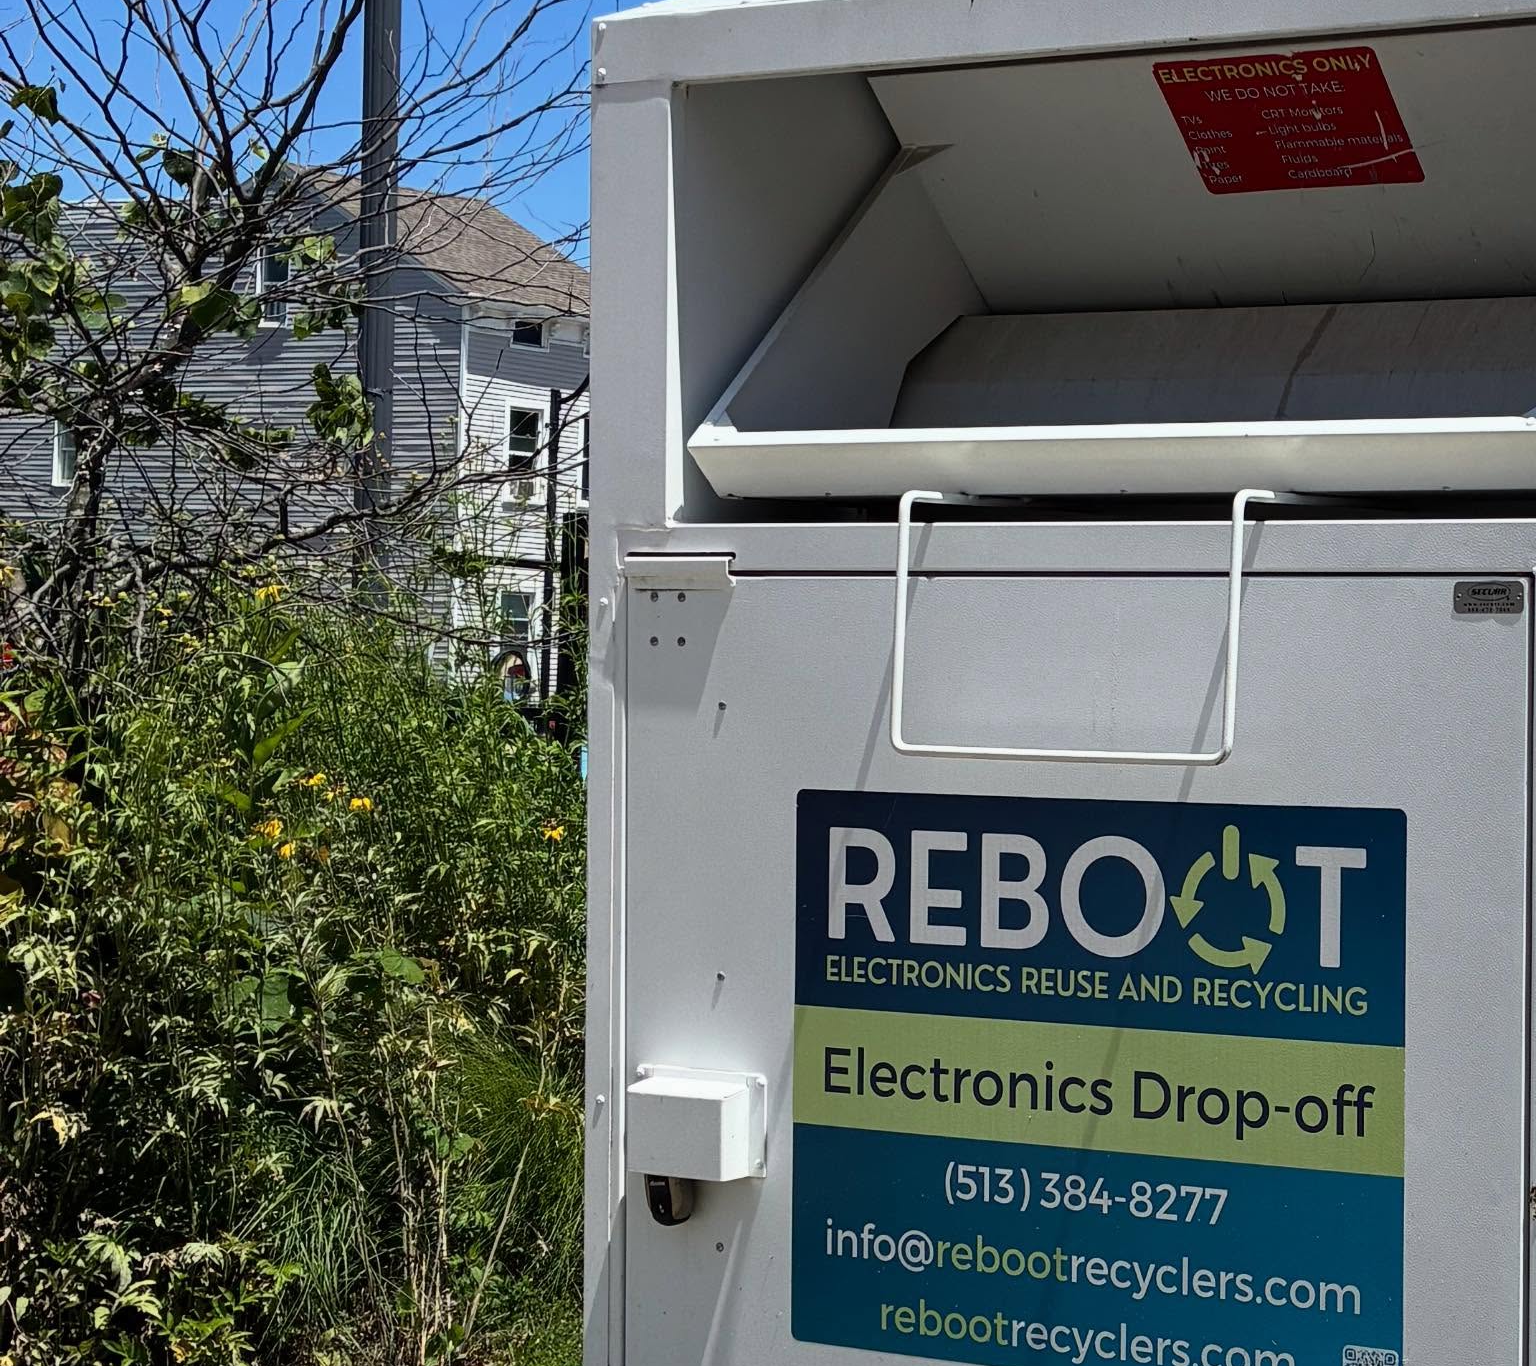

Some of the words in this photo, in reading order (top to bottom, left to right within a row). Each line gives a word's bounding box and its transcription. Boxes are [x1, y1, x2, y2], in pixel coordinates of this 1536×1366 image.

[1158, 58, 1307, 84] ELECTRONICS
[1312, 53, 1371, 73] ONLY
[1204, 88, 1232, 103] WE
[1235, 87, 1260, 101] DO
[1263, 84, 1297, 98] NOT
[1298, 80, 1346, 95] TAKE:
[1261, 108, 1286, 120] CRT
[1188, 128, 1233, 141] Clothes
[1268, 122, 1299, 137] Light
[1301, 121, 1337, 134] bulbs
[1274, 136, 1345, 150] Flammable
[1281, 152, 1319, 165] Fluids
[825, 954, 1011, 994] ELECTRONICS
[1021, 967, 1110, 1000] REUSE
[1117, 972, 1183, 1004] AND
[1192, 978, 1369, 1017] RECYCLING
[823, 1045, 1114, 1117] Electronics
[1132, 1070, 1376, 1142] Drop-off
[944, 1159, 1032, 1212] (513)
[1039, 1171, 1229, 1226] 384-8277
[825, 1217, 1362, 1316] info@rebootrecyclers.com
